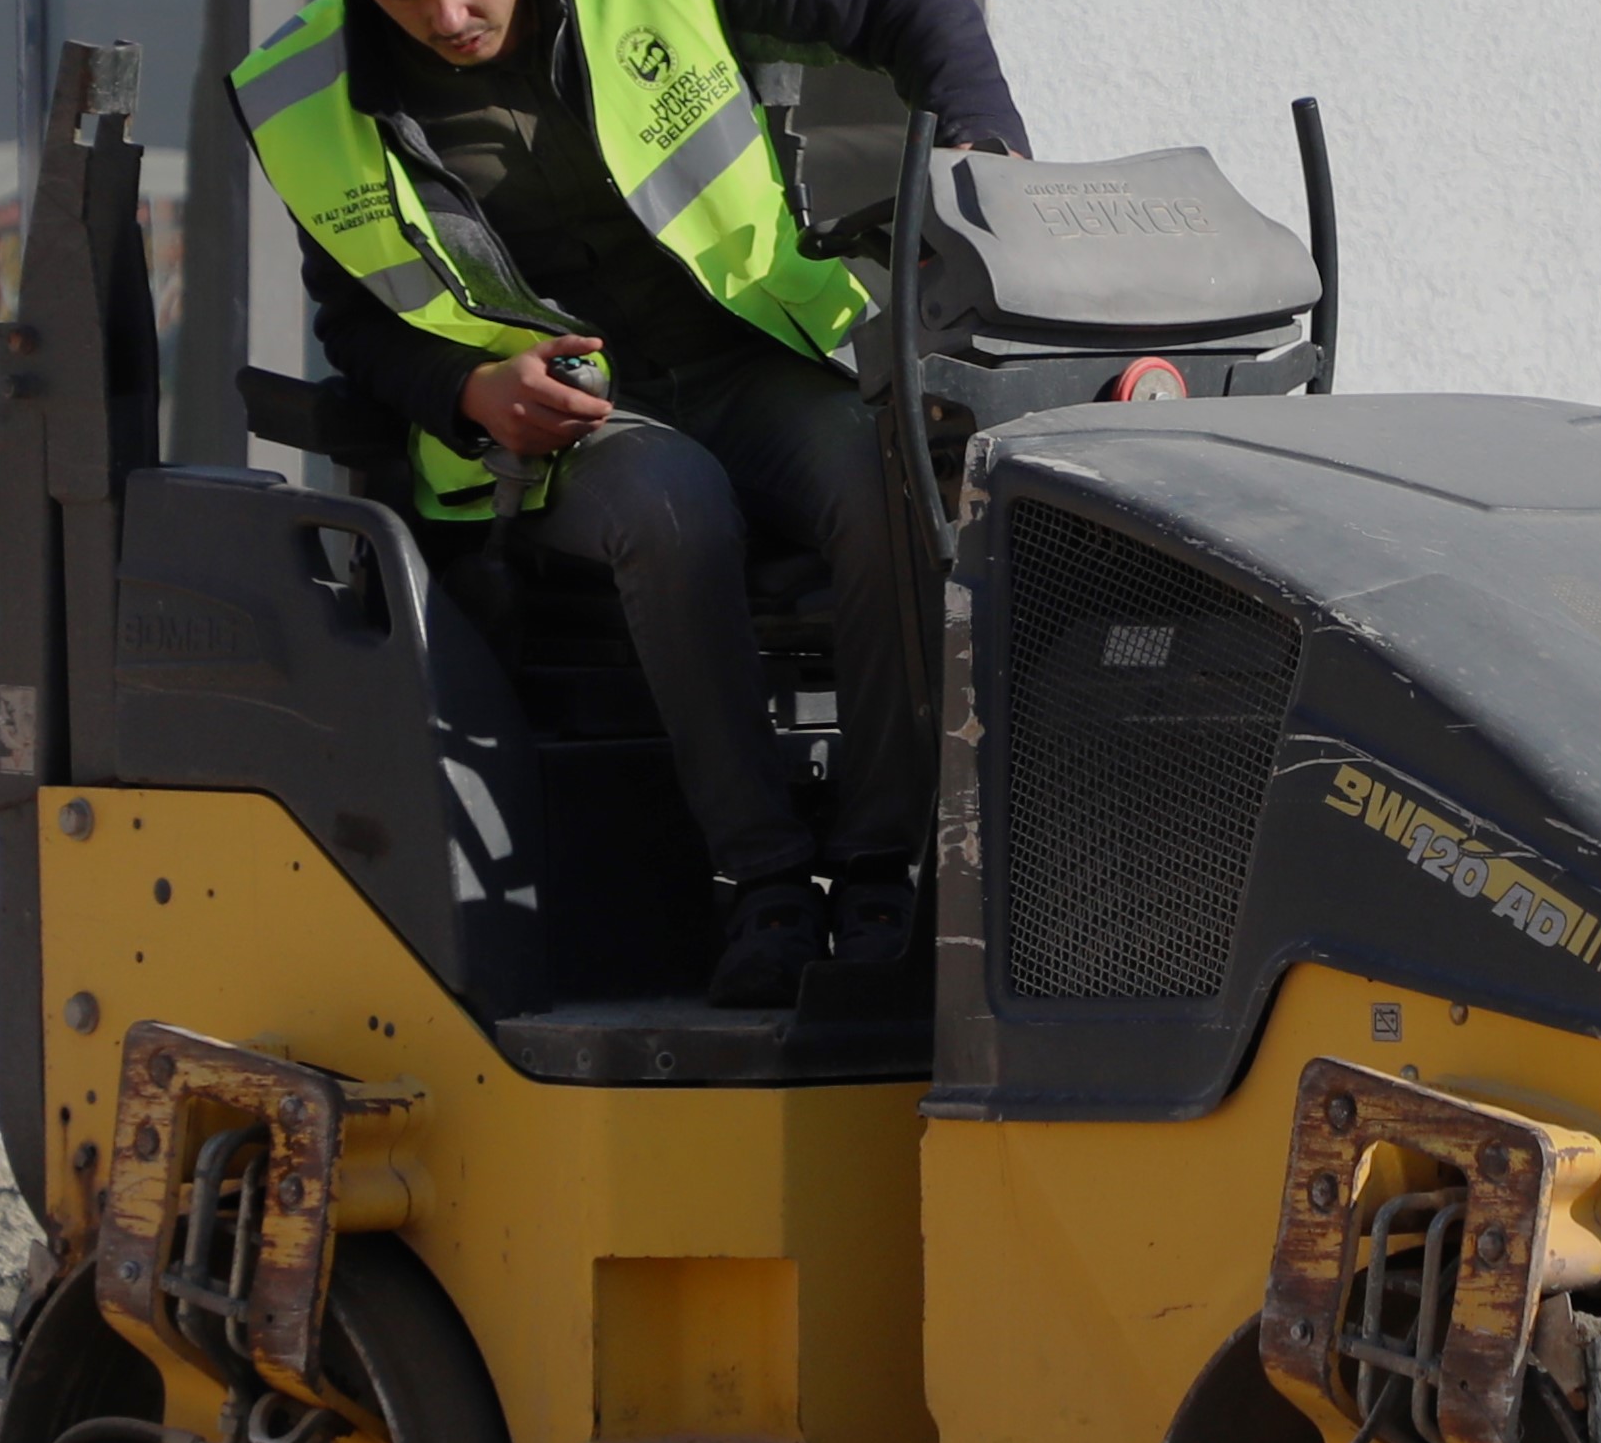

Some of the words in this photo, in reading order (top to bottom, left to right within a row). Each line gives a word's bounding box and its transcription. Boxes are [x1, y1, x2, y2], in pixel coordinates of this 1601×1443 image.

[650, 65, 698, 115] HATAY
[1024, 182, 1079, 197] GROUP
[311, 213, 323, 226] VE
[325, 207, 339, 221] ALT
[1032, 197, 1219, 238] BOMAG
[1406, 824, 1490, 899] 120
[1491, 881, 1567, 947] AD
